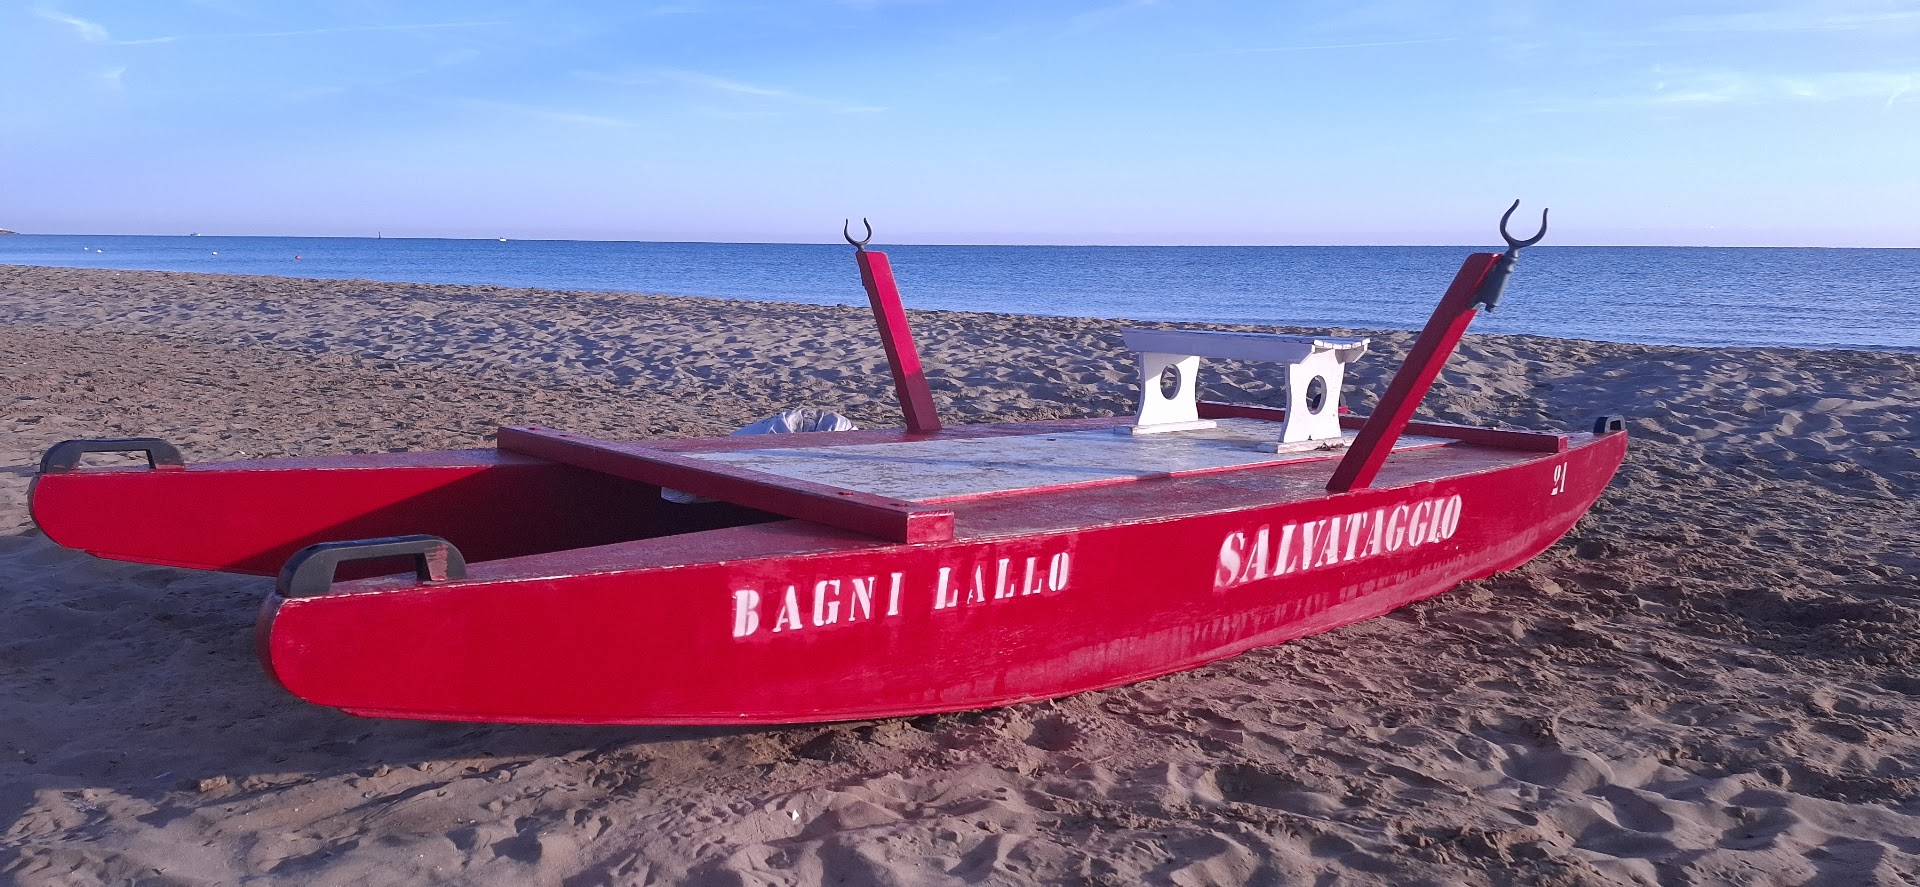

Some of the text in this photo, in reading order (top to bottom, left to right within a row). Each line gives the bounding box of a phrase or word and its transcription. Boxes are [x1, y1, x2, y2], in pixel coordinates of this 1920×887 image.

[1551, 461, 1568, 496] 21
[1213, 494, 1463, 589] SALVATAGGIO
[732, 552, 1071, 638] BAGNI LALLO
